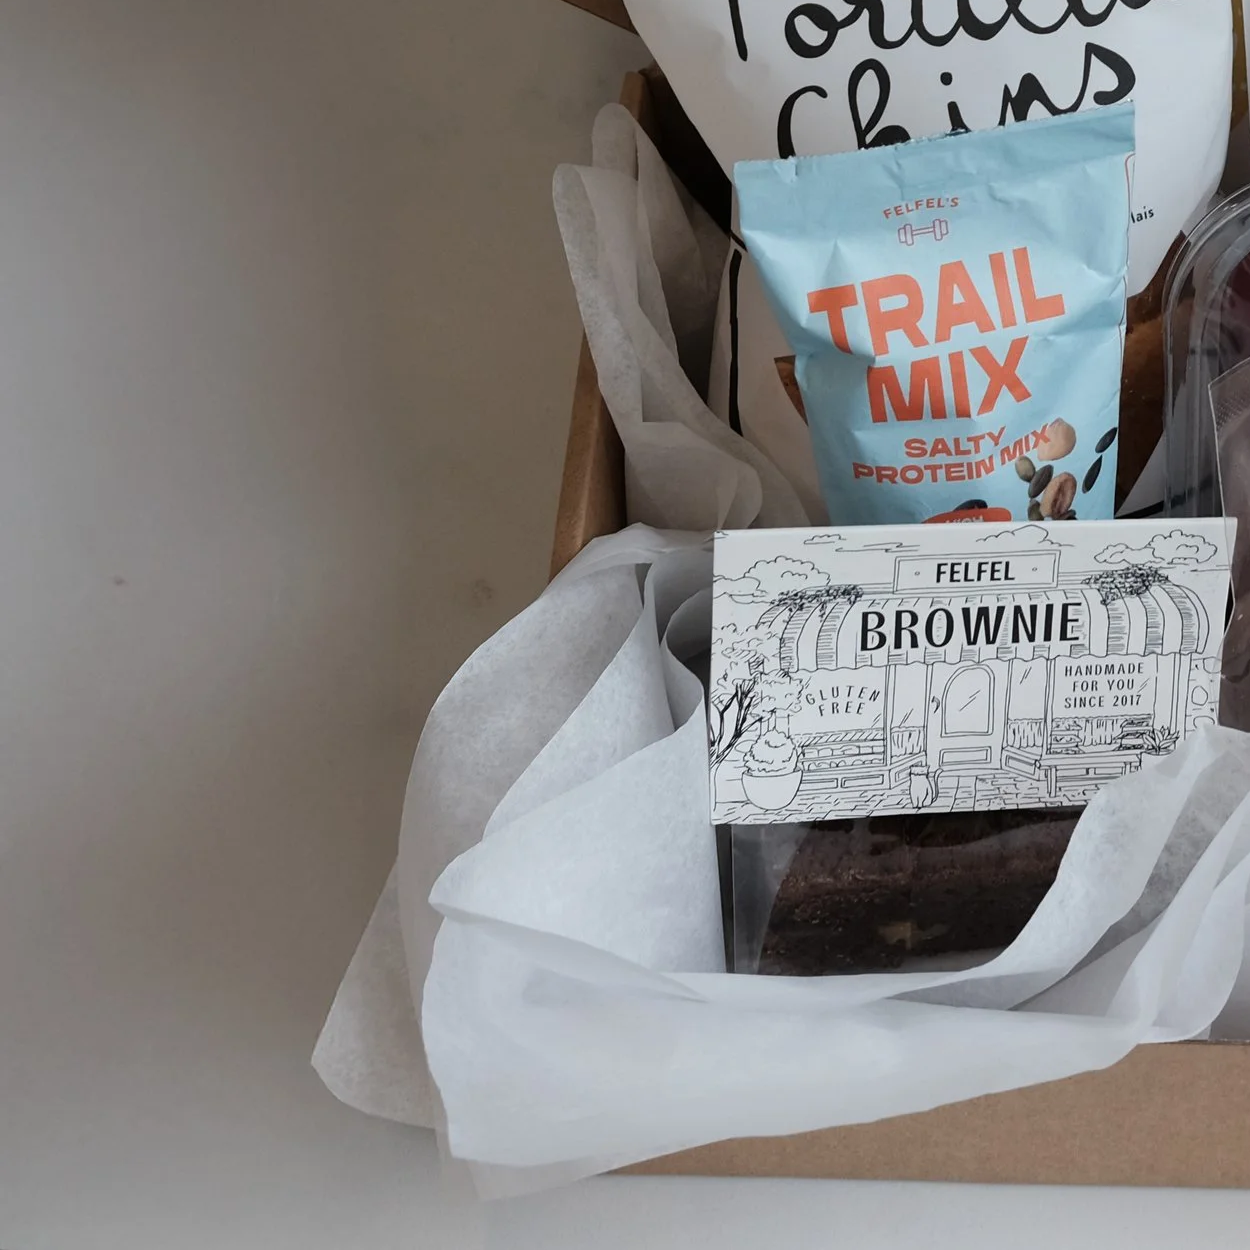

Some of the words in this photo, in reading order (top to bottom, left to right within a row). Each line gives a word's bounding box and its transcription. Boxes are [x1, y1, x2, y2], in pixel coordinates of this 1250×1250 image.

[883, 196, 960, 219] FELFEL'S
[807, 247, 1065, 356] TRAIL
[867, 335, 1032, 423] MIX
[904, 425, 1006, 458] SALTY
[852, 454, 995, 484] PROTEIN
[1000, 423, 1052, 466] MIX
[936, 561, 1015, 583] FELFEL
[860, 602, 1082, 651] BROWNIE
[1064, 662, 1144, 677] HANDMADE
[805, 684, 881, 706] GLUTEN
[1073, 679, 1099, 692] FOR
[1106, 678, 1135, 691] YOU
[818, 701, 866, 717] FREE
[1064, 695, 1104, 709] SINCE
[1112, 694, 1142, 707] 2017
